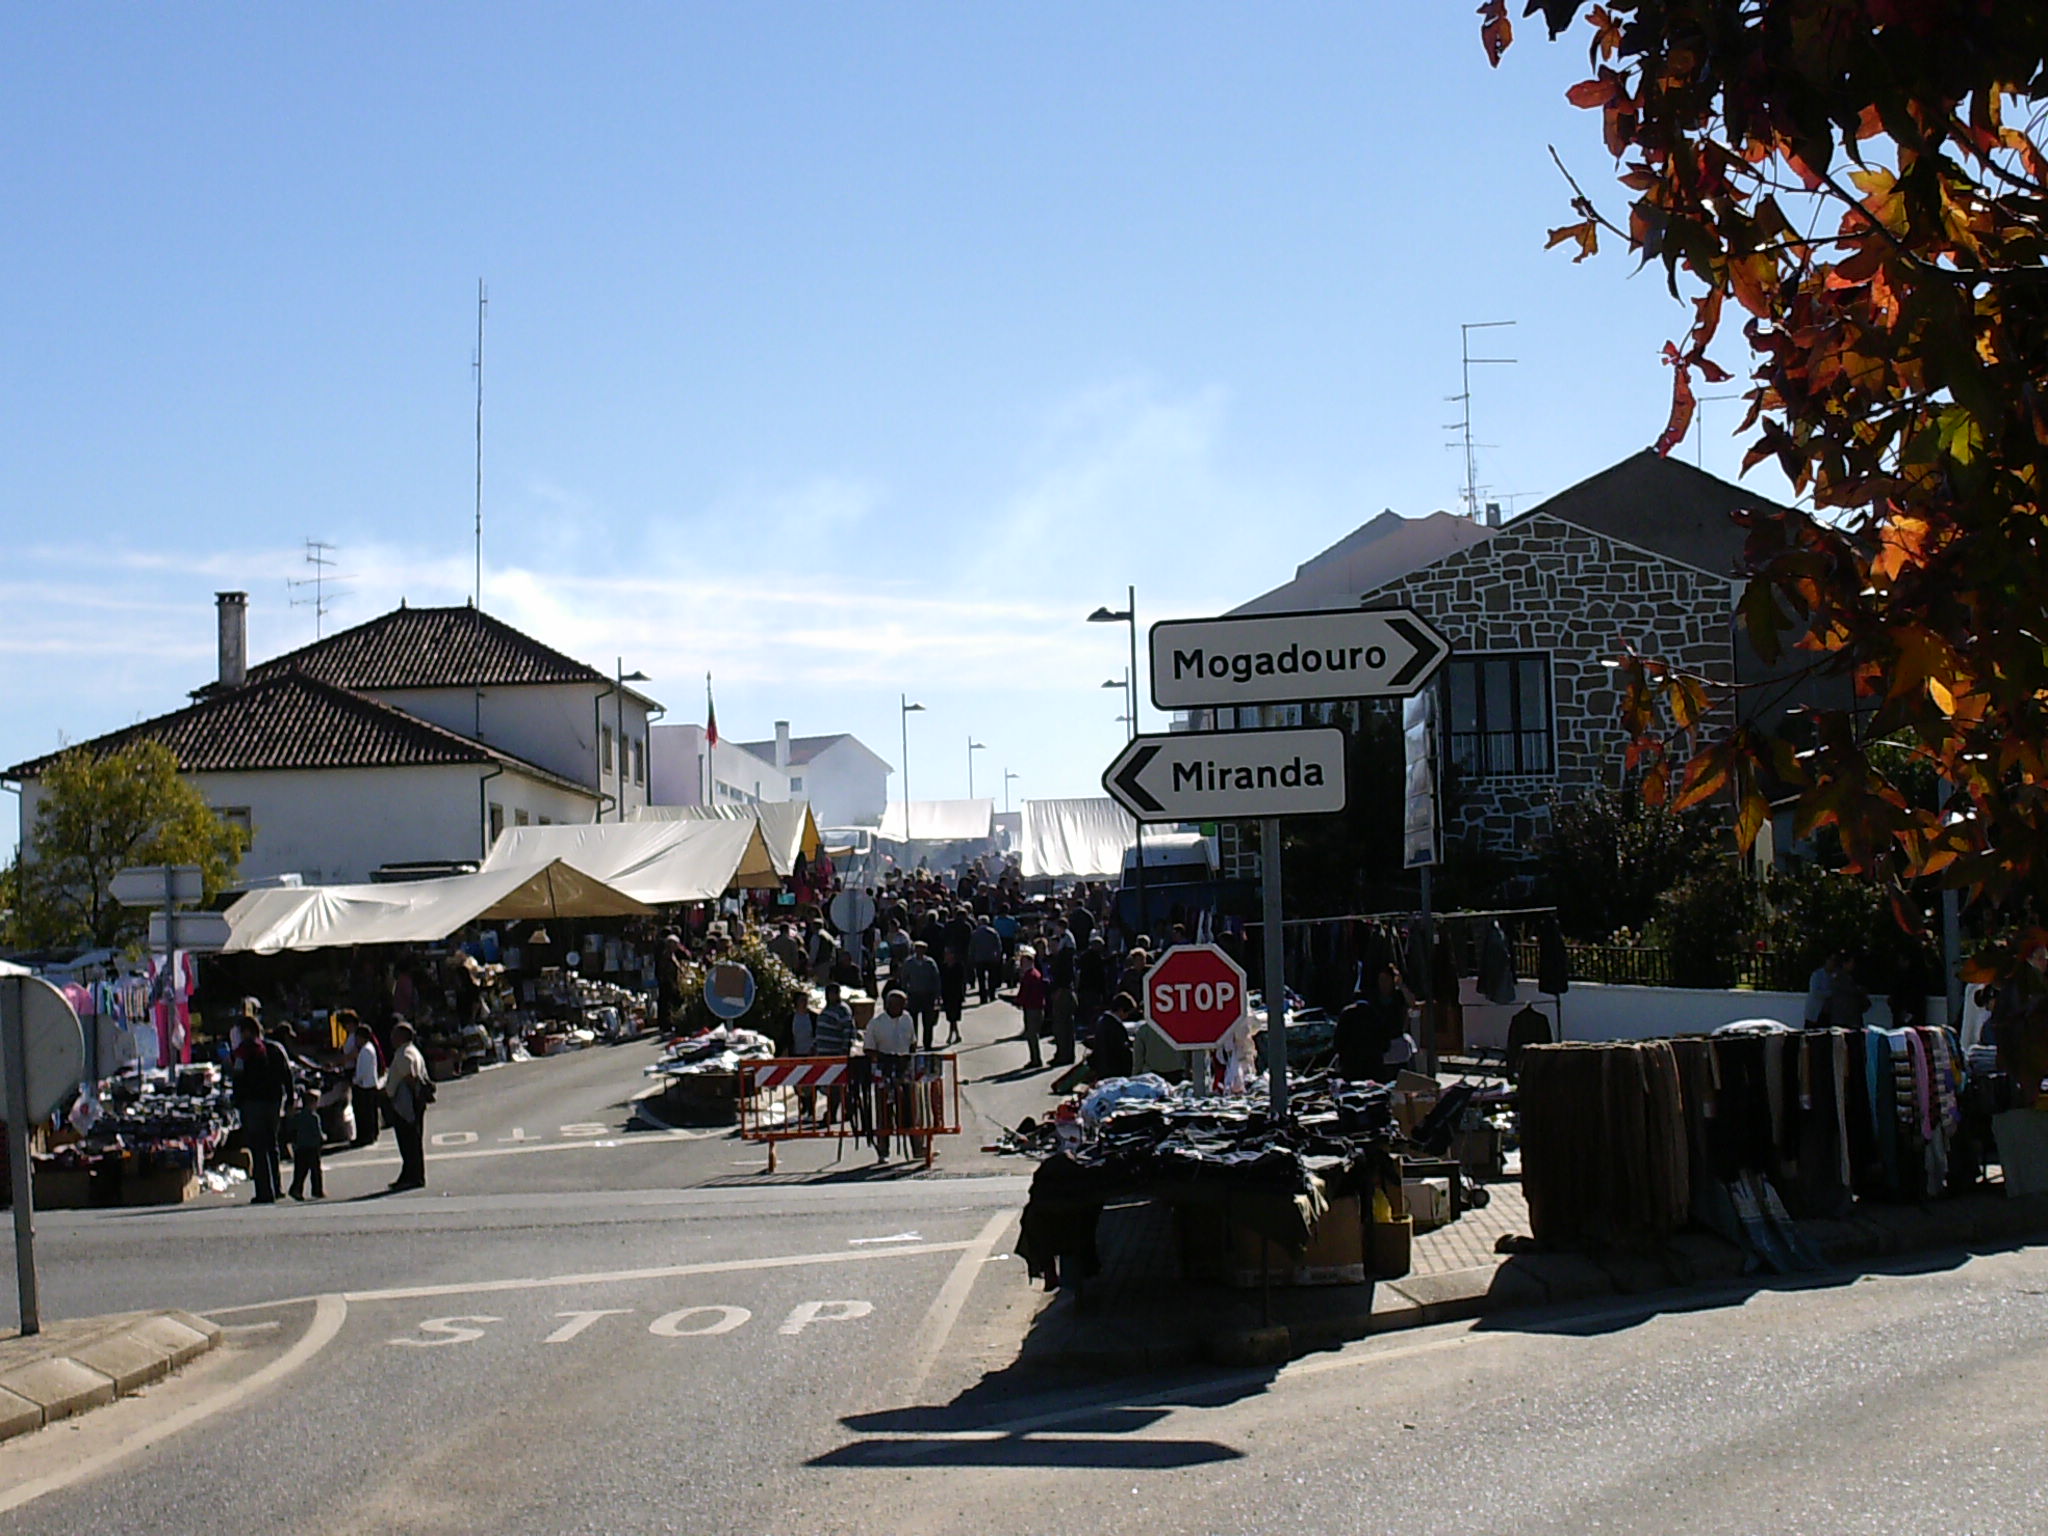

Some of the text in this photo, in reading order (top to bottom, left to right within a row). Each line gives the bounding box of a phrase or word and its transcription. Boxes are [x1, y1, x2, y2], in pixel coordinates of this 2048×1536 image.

[1172, 643, 1386, 682] Mogadouro
[1172, 757, 1324, 792] Miranda
[1155, 982, 1235, 1012] STOP
[387, 1300, 874, 1346] STOP
